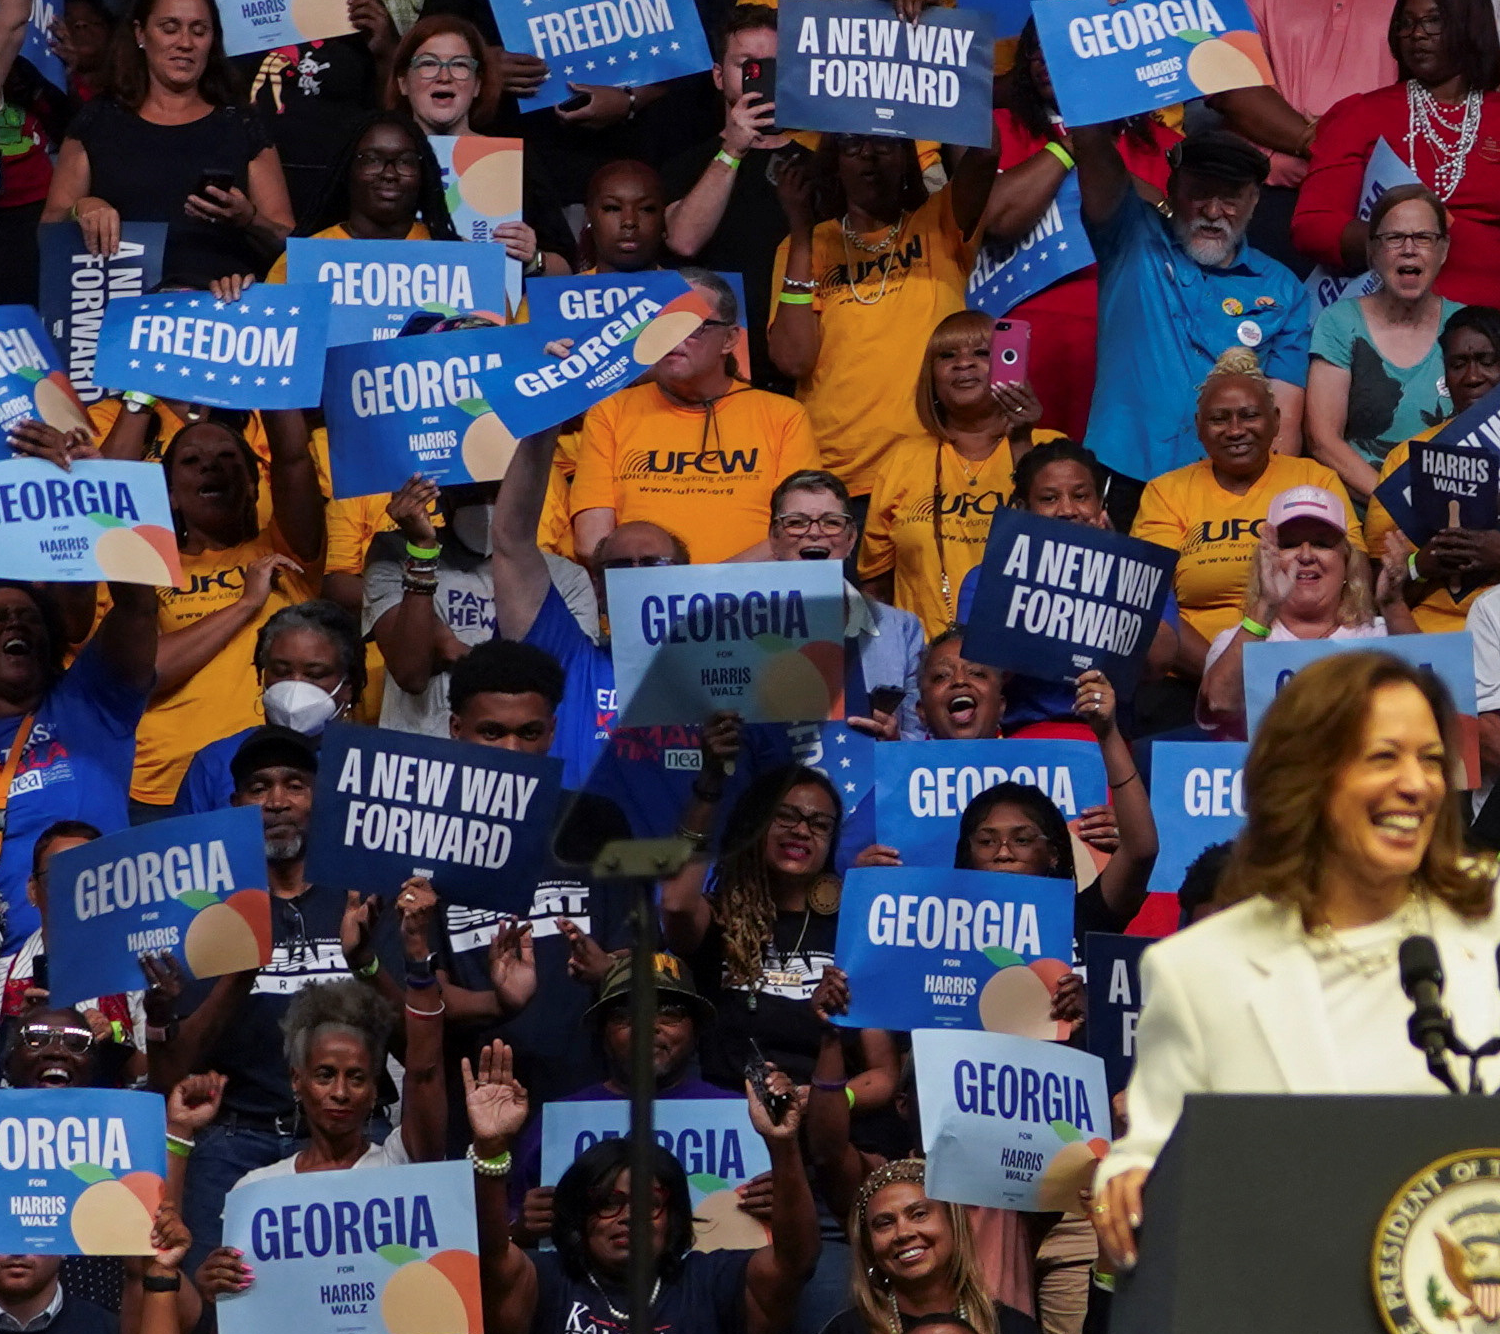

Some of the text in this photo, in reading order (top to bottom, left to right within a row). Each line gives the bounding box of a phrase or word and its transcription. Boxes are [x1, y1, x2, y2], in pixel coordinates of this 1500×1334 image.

[797, 18, 974, 65] A NEW WAY
[809, 61, 960, 108] FORWARD
[131, 314, 297, 369] FREEDOM
[515, 295, 663, 398] GEORGIA
[647, 450, 758, 474] UFCW
[639, 485, 735, 497] www.ufcw.org
[668, 753, 700, 767] nea
[337, 748, 539, 821] A NEW WAY
[345, 798, 512, 869] FORWARD
[868, 893, 1041, 954] GEORGIA
[925, 975, 977, 995] HARRIS
[10, 1196, 65, 1215] HARRIS
[20, 1215, 58, 1226] WALZ
[1380, 1171, 1442, 1310] PRESIDENT
[1450, 1162, 1481, 1182] OF
